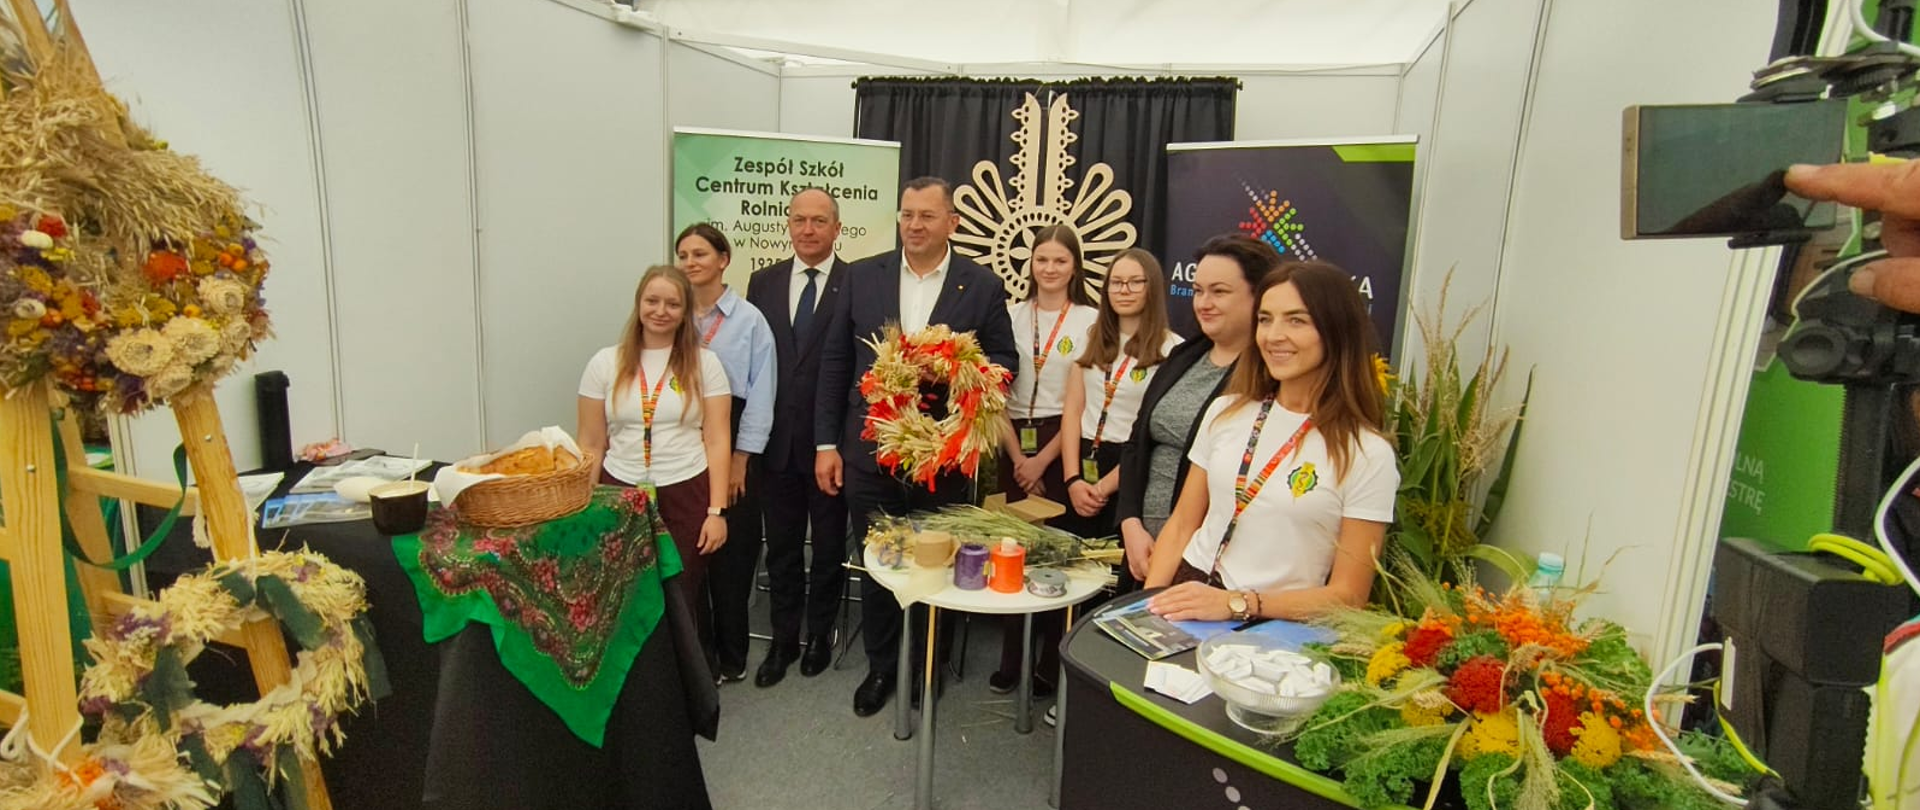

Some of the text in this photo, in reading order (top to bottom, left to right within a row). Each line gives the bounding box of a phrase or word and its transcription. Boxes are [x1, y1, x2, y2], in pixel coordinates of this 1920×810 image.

[734, 156, 844, 178] Zespół Szkół
[695, 176, 774, 196] Centrum
[741, 199, 790, 217] Rolnic
[733, 219, 788, 236] Augusty
[733, 238, 746, 248] w
[1170, 284, 1194, 297] Bran
[1736, 452, 1764, 484] LNĄ
[1730, 480, 1765, 515] STRĘ
